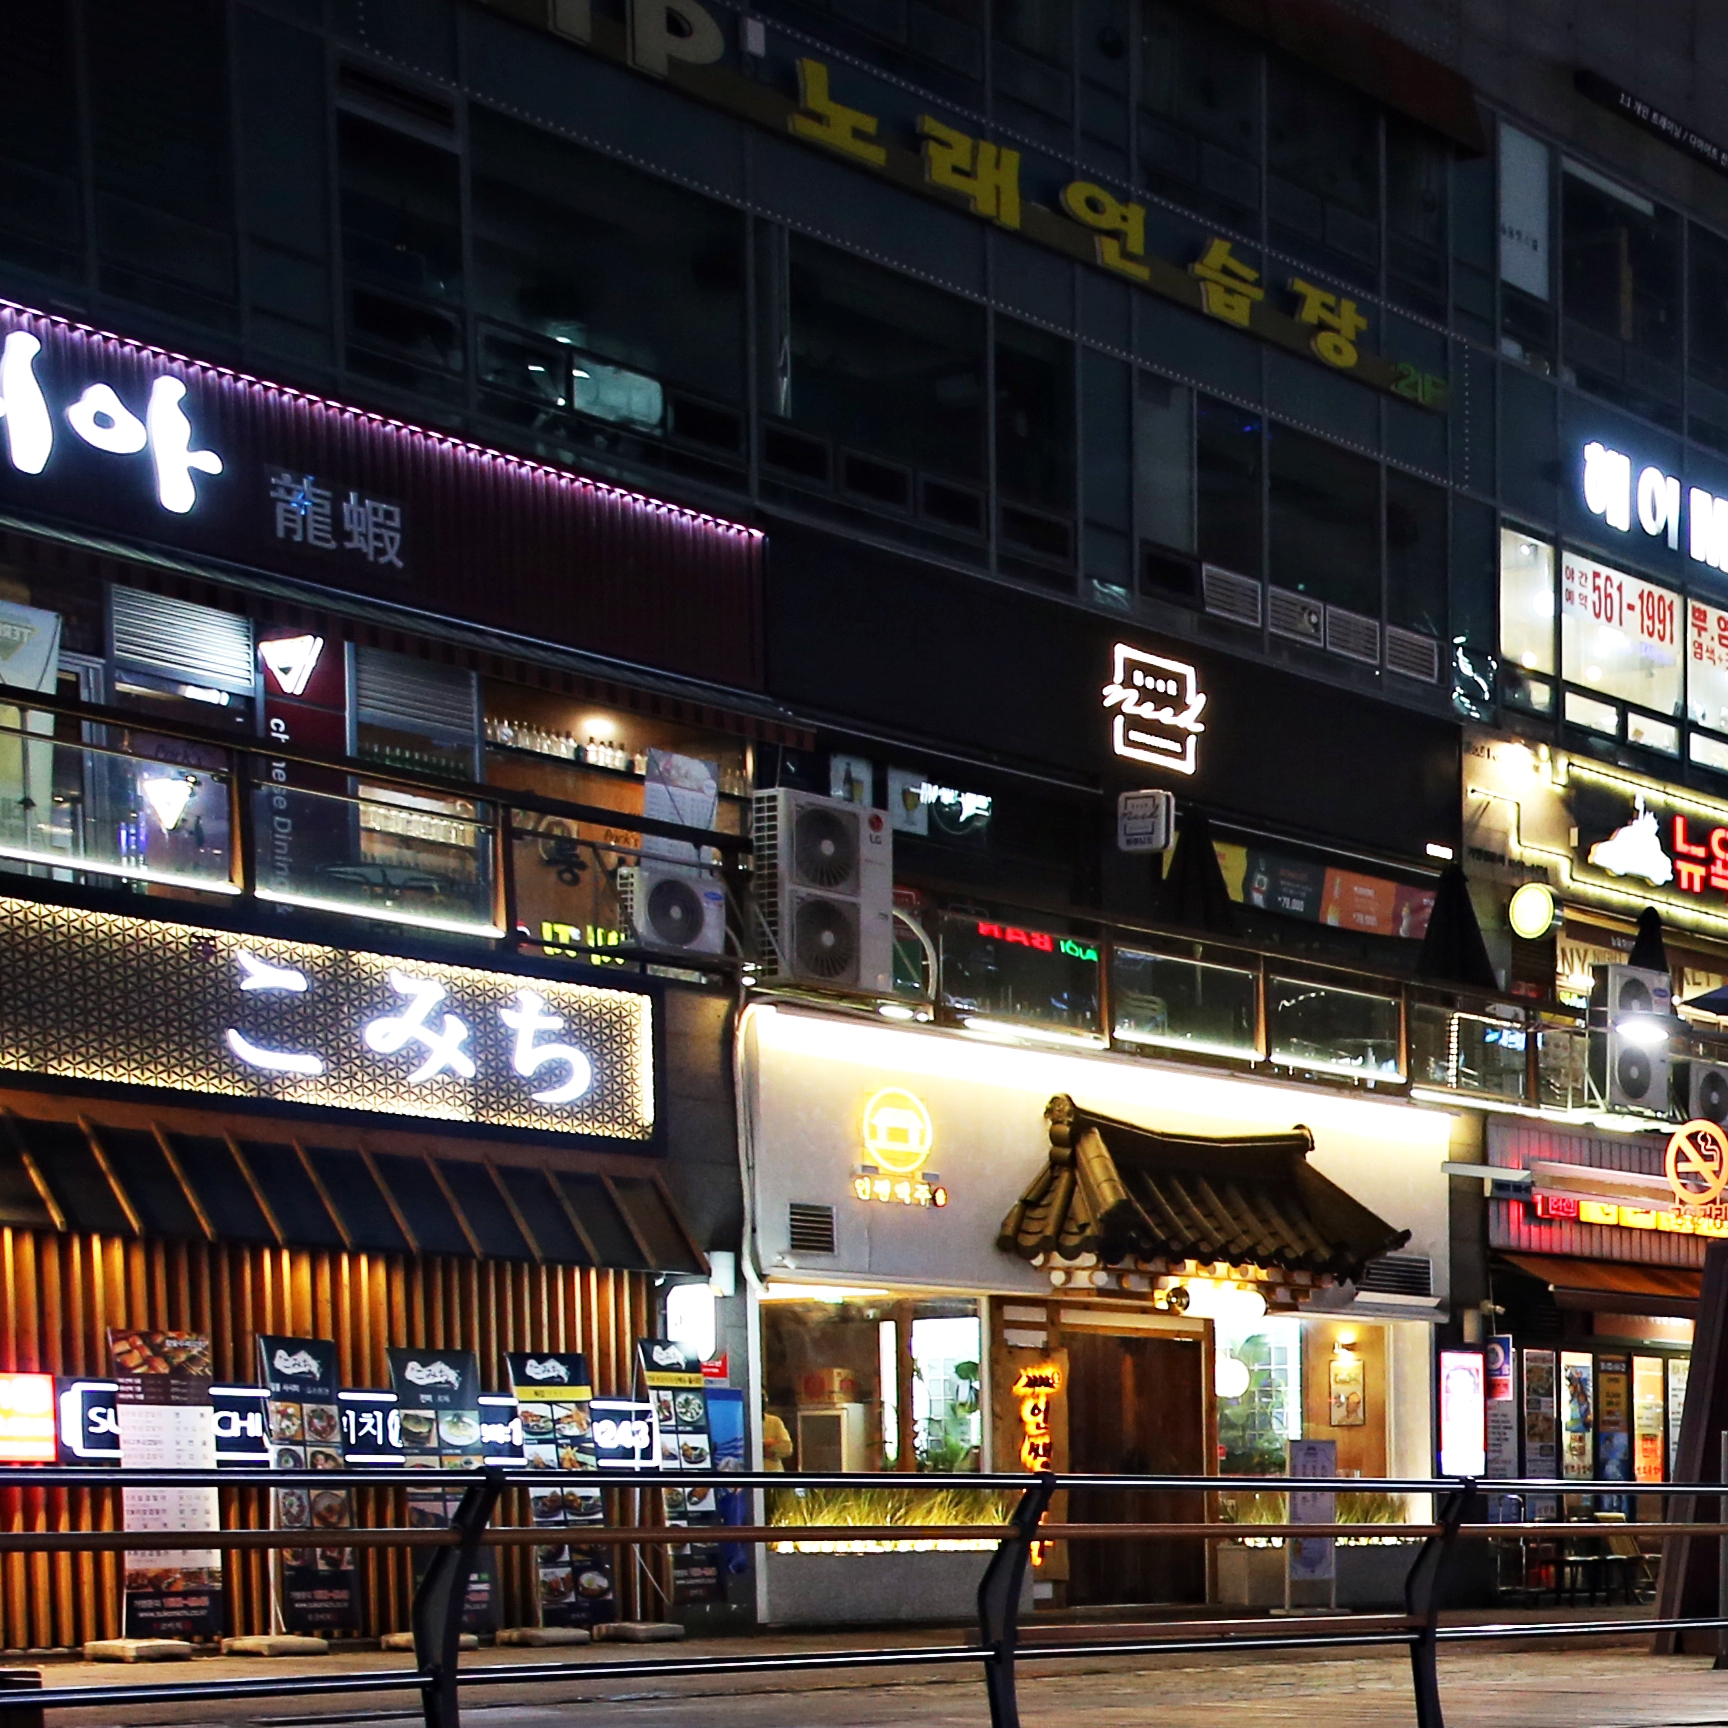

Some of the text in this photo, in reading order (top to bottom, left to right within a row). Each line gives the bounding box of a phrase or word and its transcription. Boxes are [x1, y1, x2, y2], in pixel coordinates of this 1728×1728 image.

[787, 58, 1368, 369] 노래연습장
[271, 474, 405, 569] 龍蝦
[1591, 569, 1675, 646] 561-1991
[228, 949, 593, 1104] こみち
